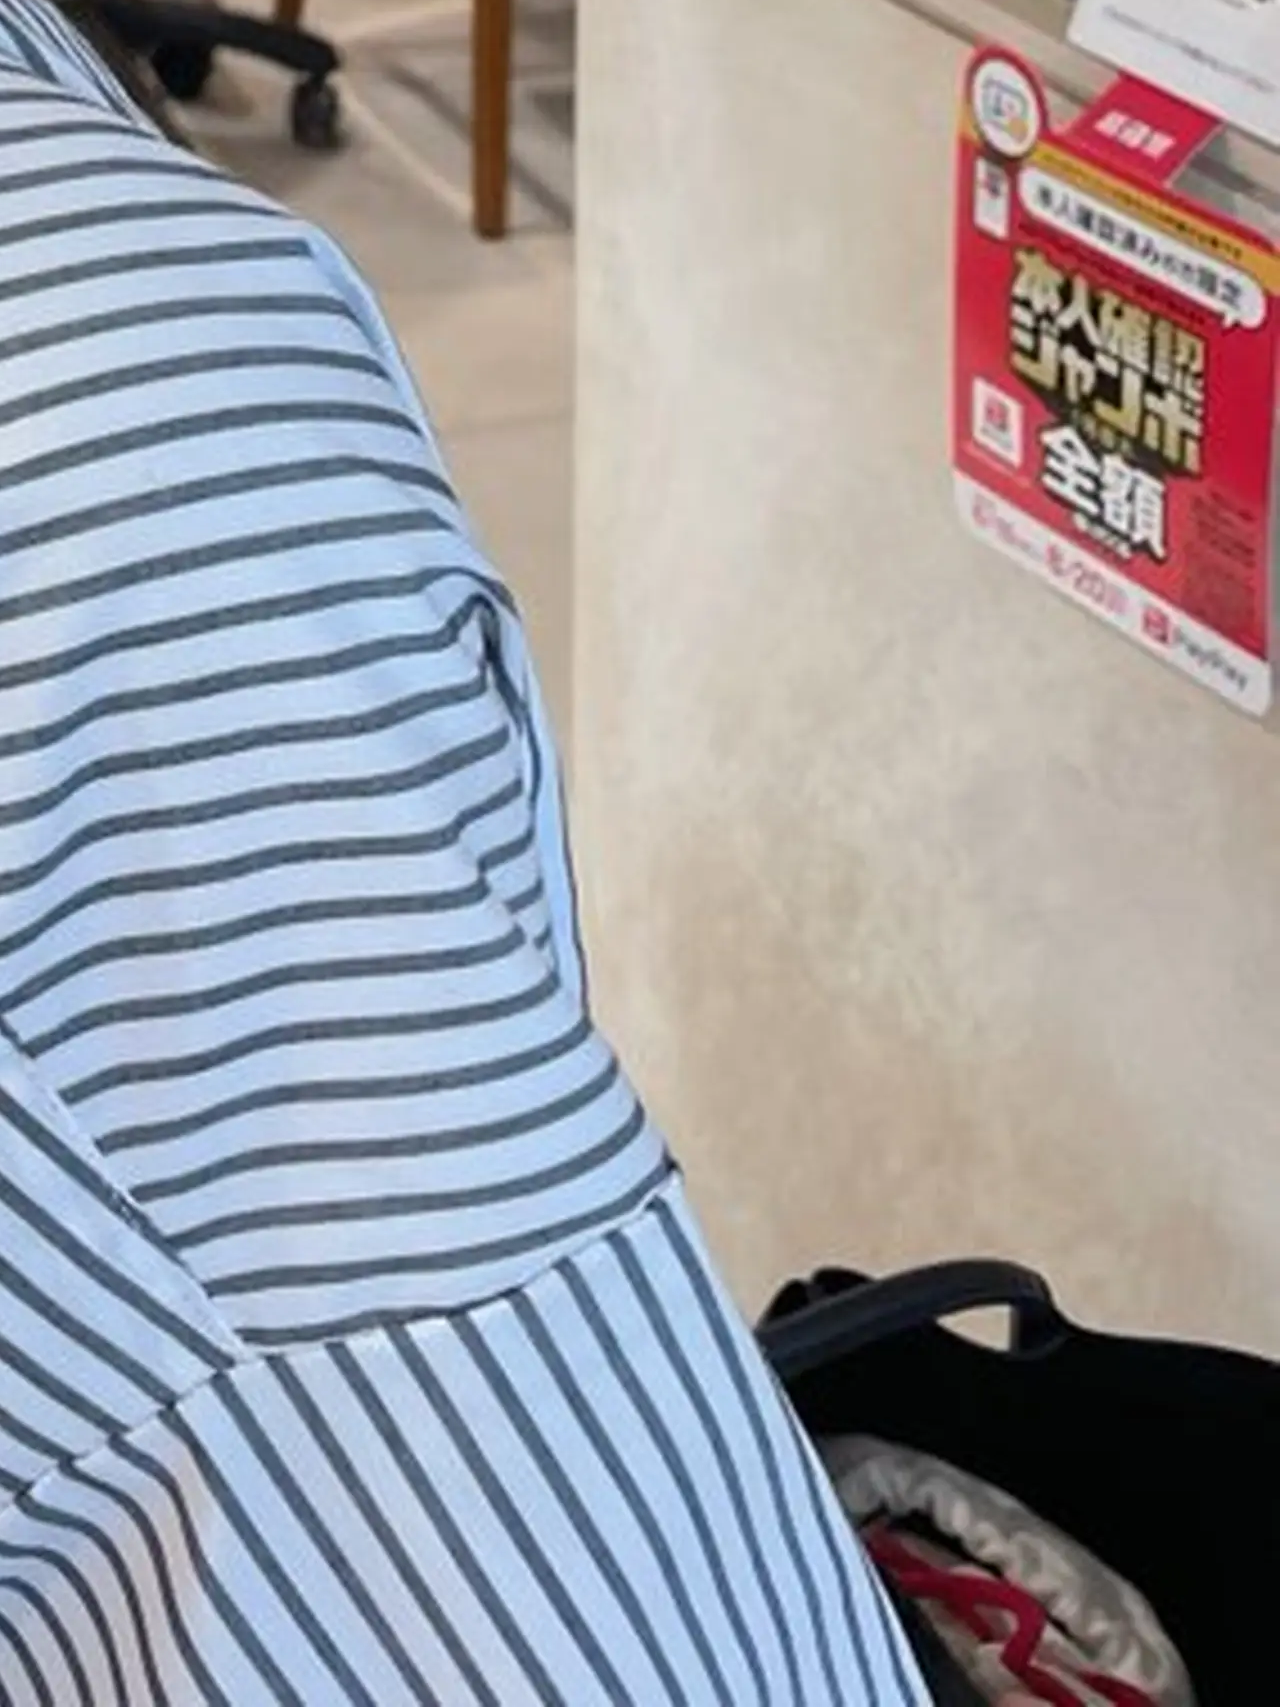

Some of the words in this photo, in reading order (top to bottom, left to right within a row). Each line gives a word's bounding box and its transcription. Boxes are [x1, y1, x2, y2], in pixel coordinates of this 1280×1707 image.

[1010, 303, 1204, 477] ジャンボ
[1011, 247, 1206, 403] 本人確認
[1040, 424, 1167, 561] 全額
